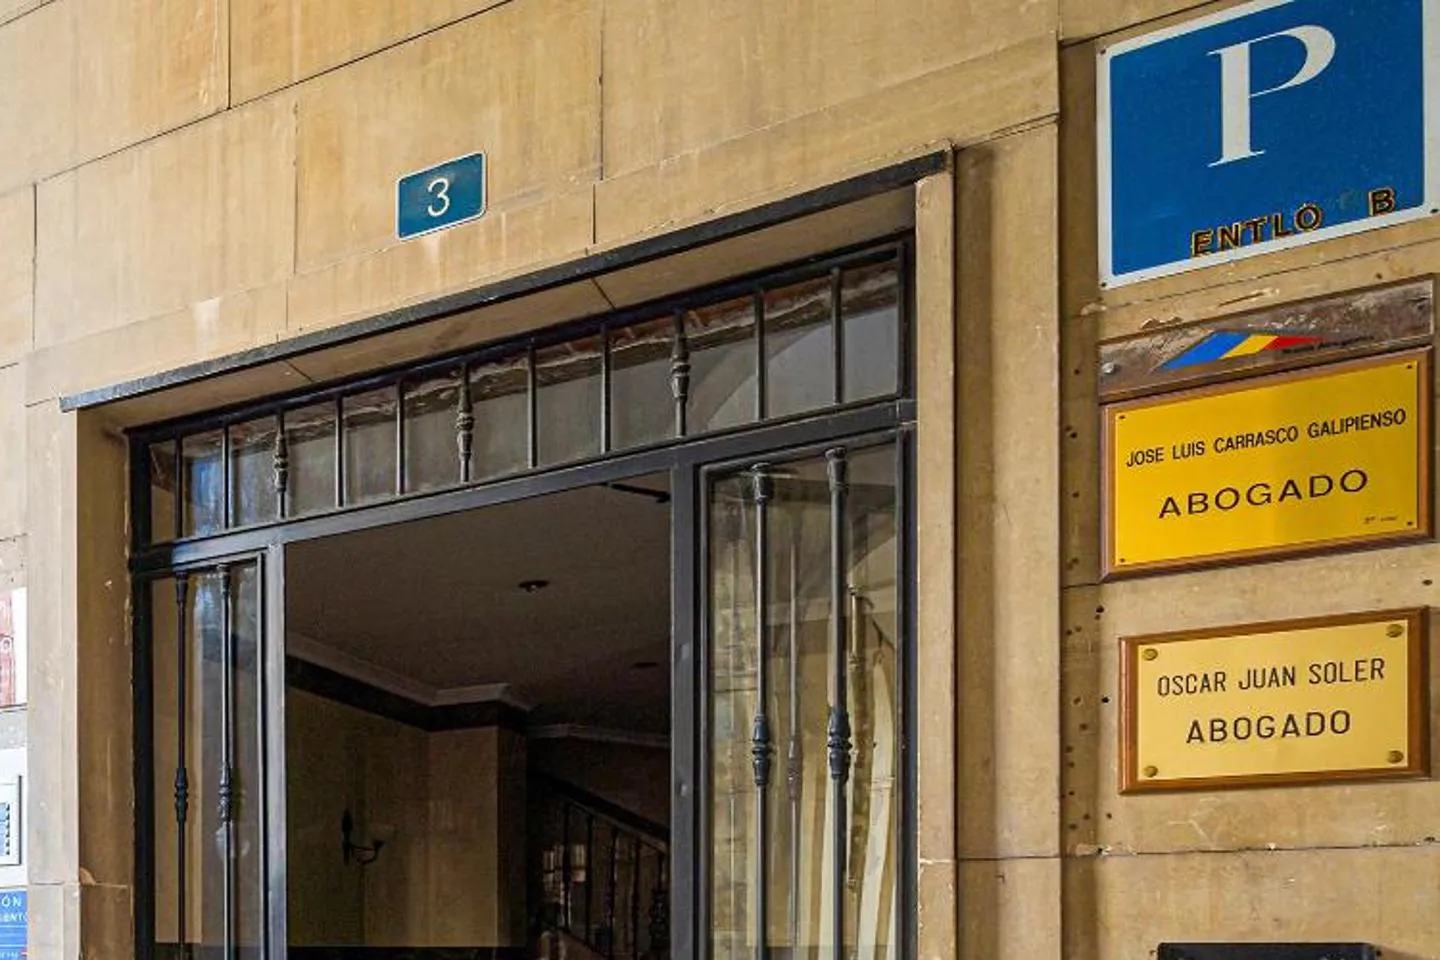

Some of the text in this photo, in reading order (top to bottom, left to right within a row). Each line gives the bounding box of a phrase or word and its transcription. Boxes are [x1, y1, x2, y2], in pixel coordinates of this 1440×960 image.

[1206, 24, 1336, 168] P
[427, 177, 451, 218] 3
[1368, 187, 1397, 218] B
[1126, 408, 1407, 468] JOSE LUIS CARRASCO GALIPIENSO
[1158, 469, 1368, 519] ABOGADO
[1157, 657, 1386, 697] OSCAR JUAN SOLER
[1185, 709, 1351, 744] ABOGADO
